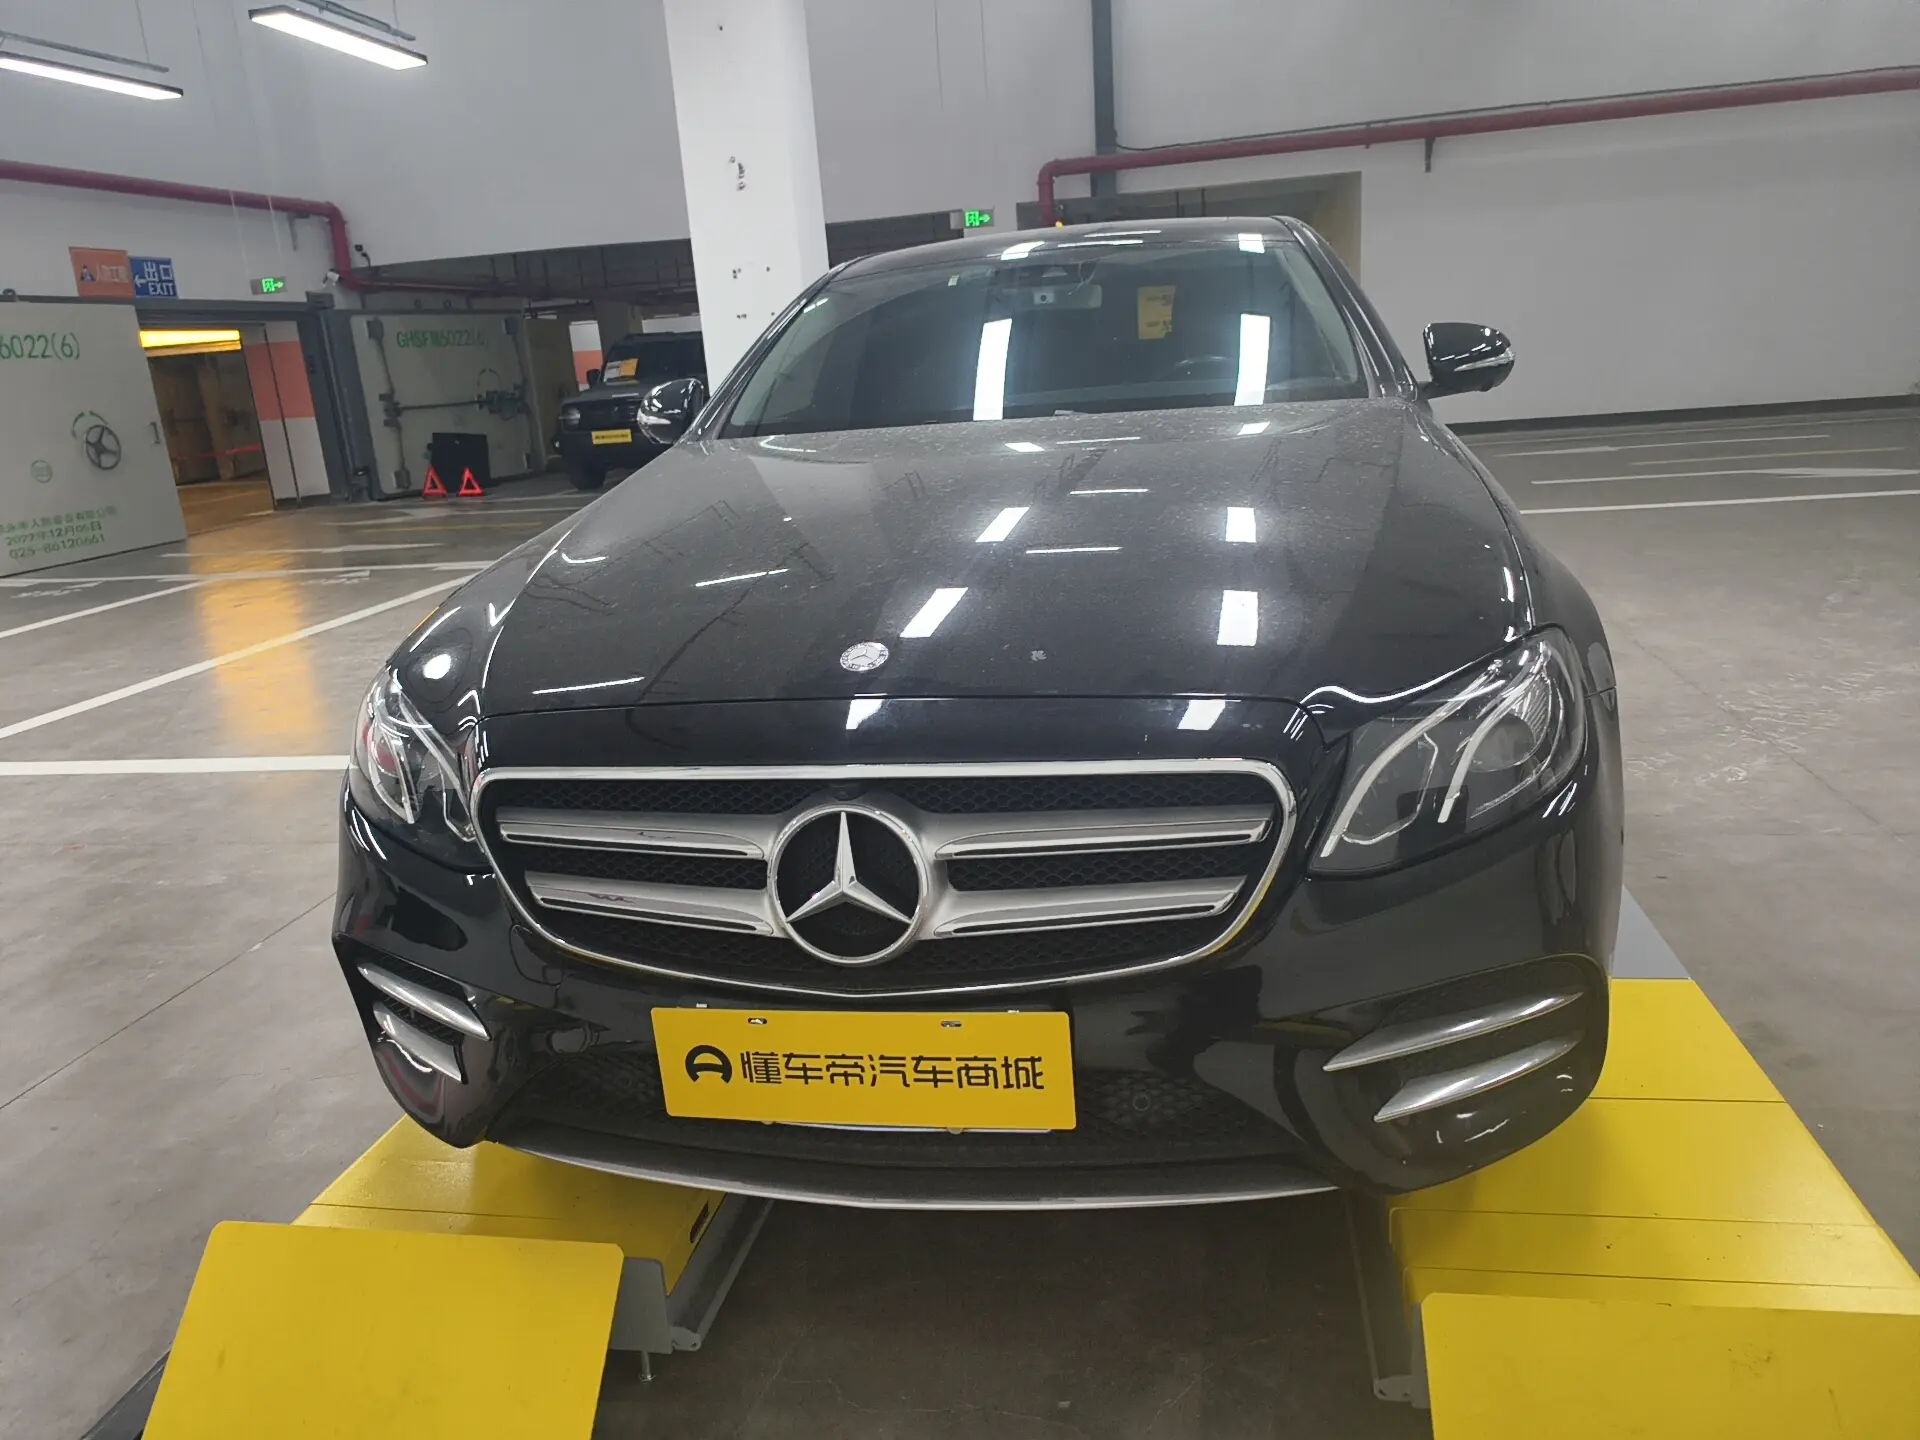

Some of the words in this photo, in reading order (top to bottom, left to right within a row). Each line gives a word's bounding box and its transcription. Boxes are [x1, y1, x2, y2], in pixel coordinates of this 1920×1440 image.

[143, 261, 173, 281] 出口
[148, 282, 174, 296] EXIT
[740, 1050, 1045, 1090] 懂车帝汽车商城
